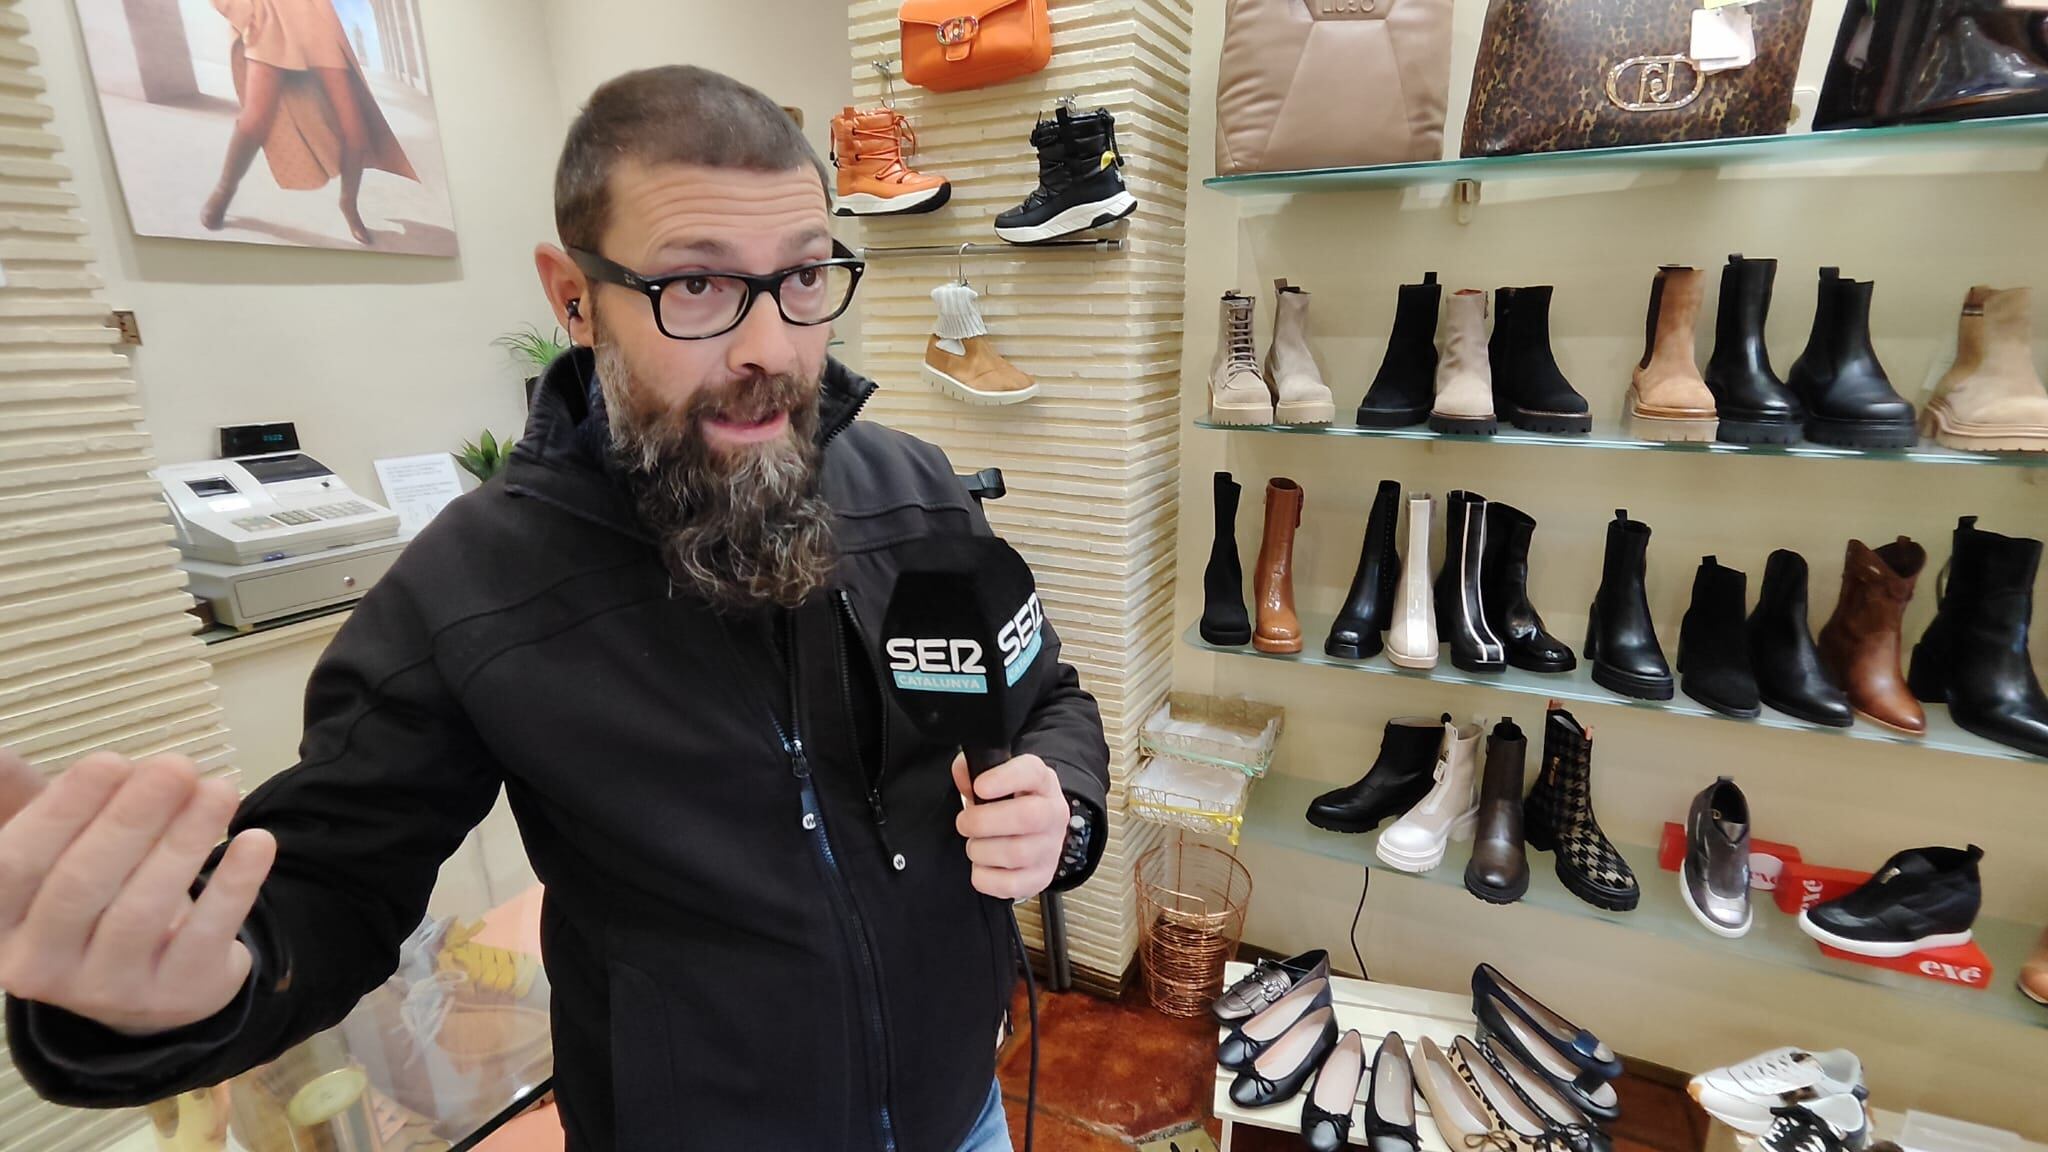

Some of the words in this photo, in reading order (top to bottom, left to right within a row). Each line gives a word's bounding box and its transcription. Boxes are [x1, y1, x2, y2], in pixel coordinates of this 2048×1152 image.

[997, 592, 1043, 667] SER
[886, 638, 987, 673] SER
[899, 675, 980, 689] CATALUNYA
